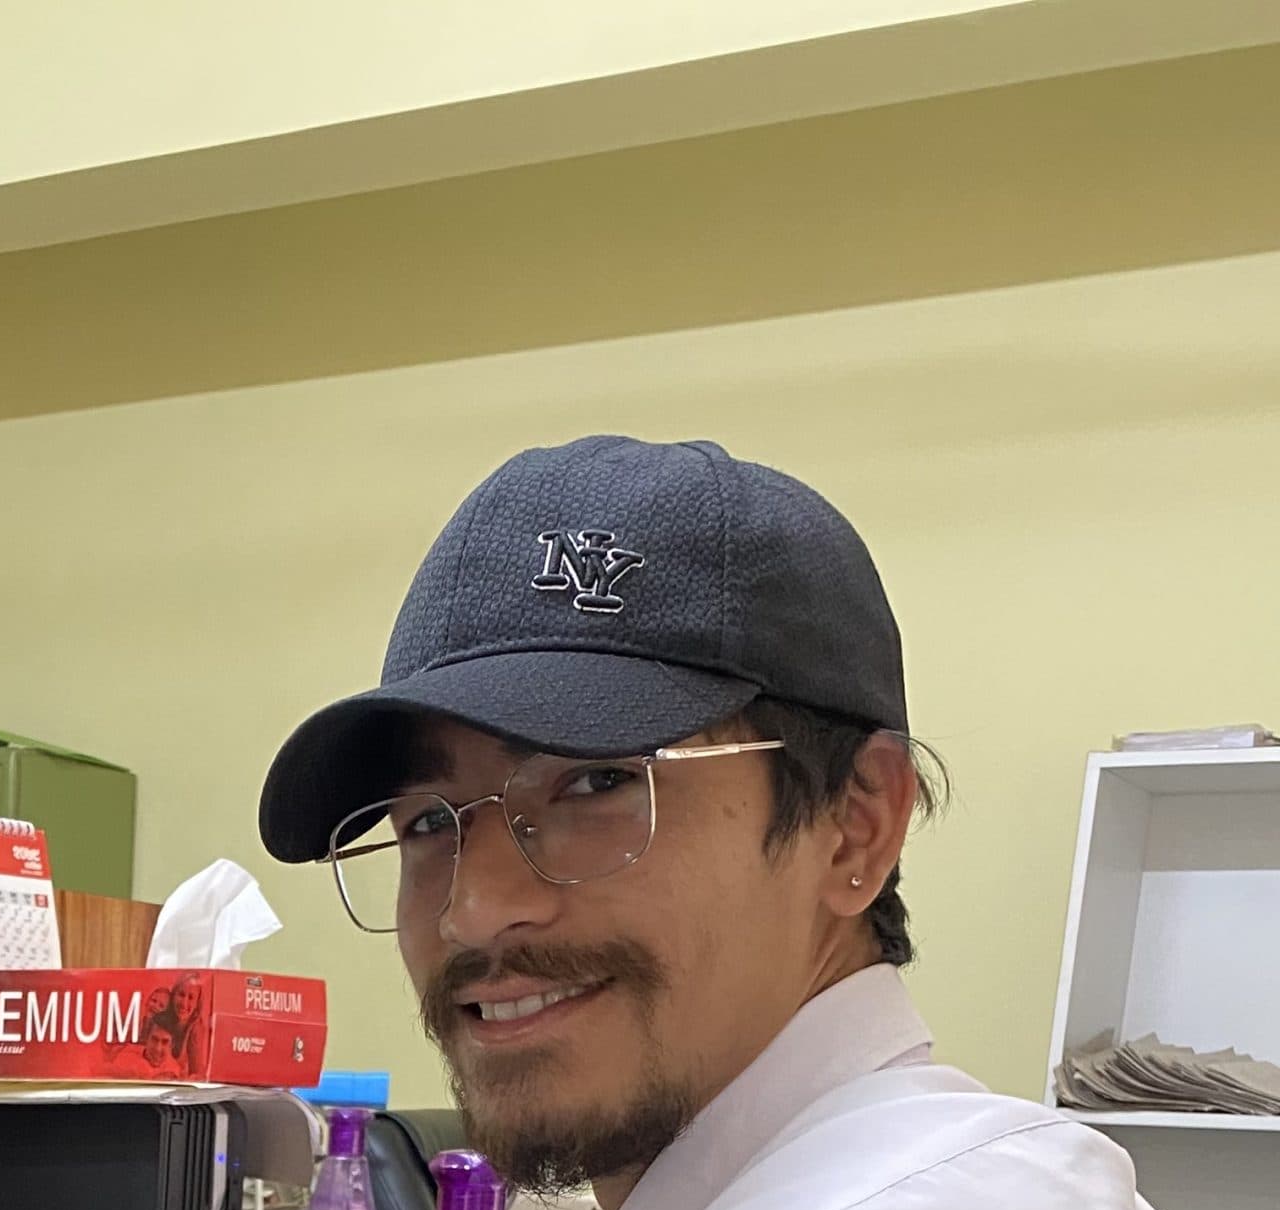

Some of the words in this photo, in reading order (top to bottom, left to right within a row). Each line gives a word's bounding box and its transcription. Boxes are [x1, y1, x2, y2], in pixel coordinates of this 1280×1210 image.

[531, 529, 645, 613] NY
[245, 989, 302, 1015] PREMIUM
[232, 1036, 250, 1052] 100
